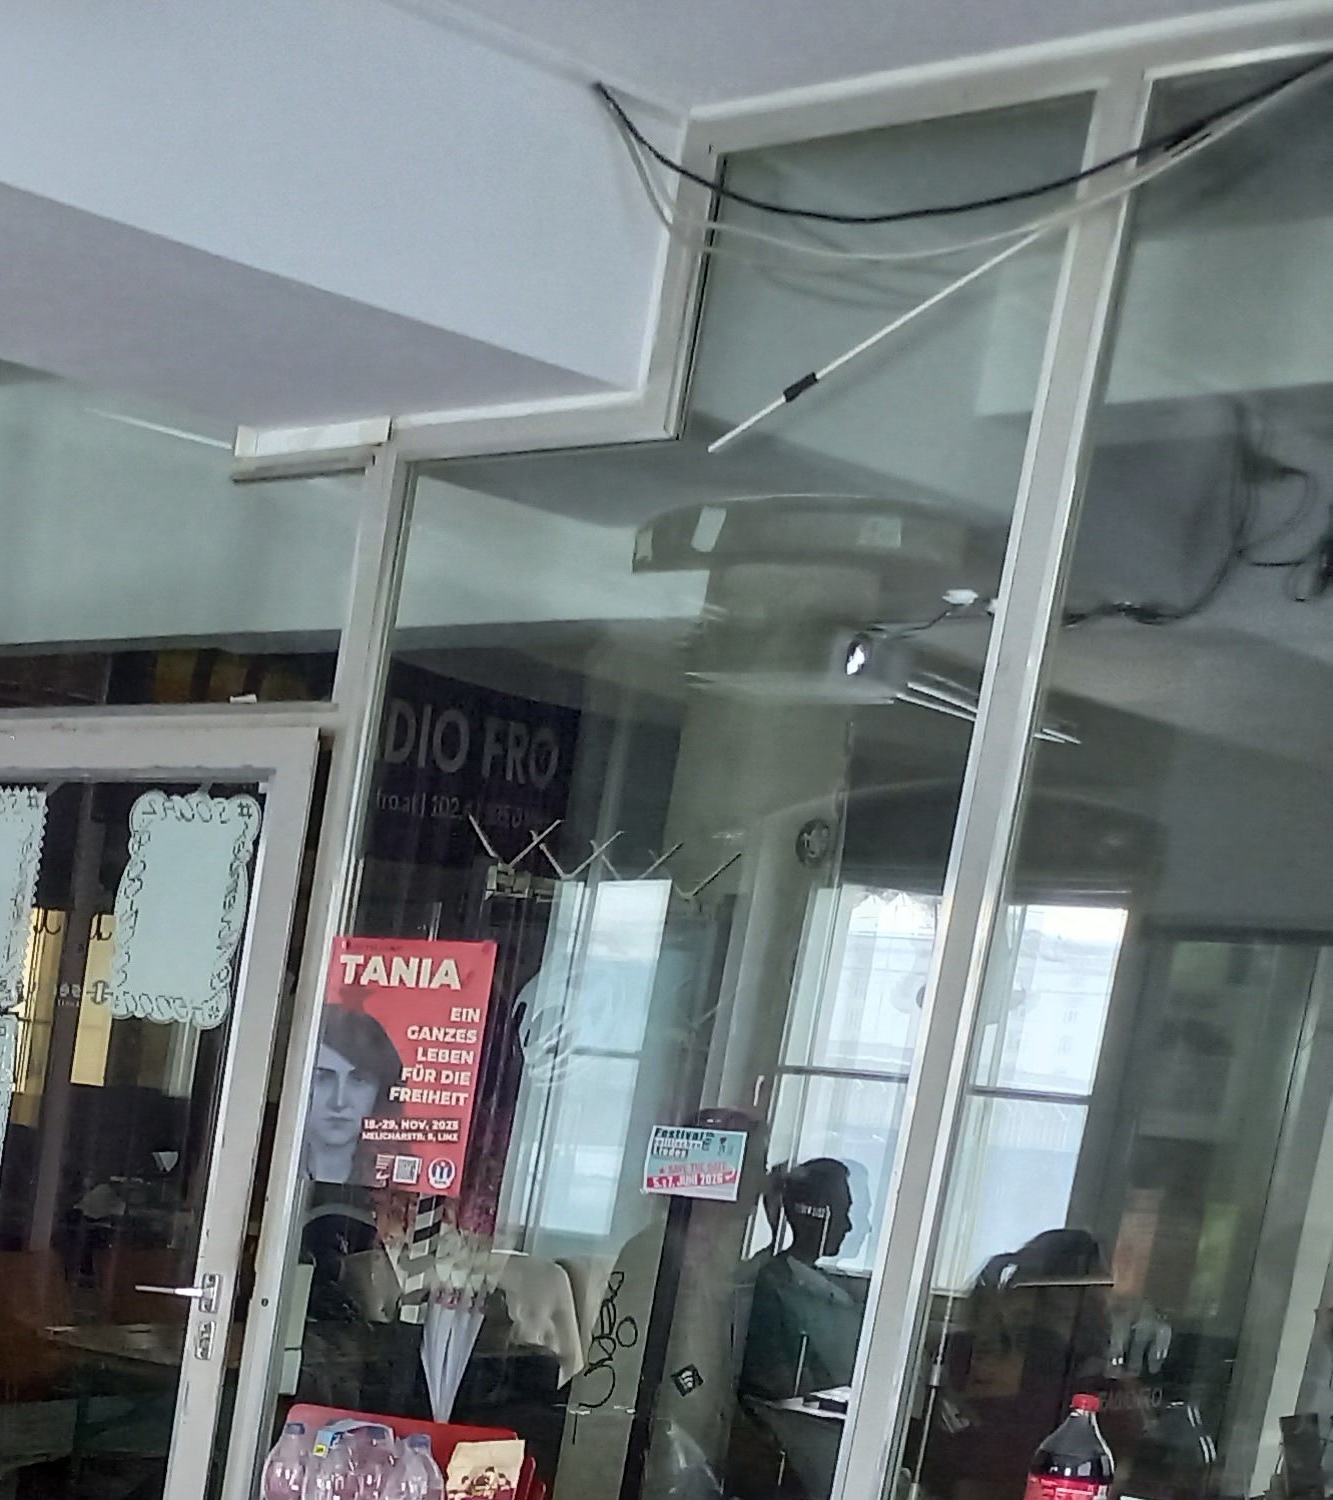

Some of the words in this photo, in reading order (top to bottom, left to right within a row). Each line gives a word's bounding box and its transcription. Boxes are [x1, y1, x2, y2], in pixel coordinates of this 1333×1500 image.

[340, 954, 462, 991] TANIA
[450, 1007, 481, 1023] EIN
[407, 1025, 478, 1044] GANZES
[416, 1047, 474, 1065] LEBEN
[401, 1064, 437, 1083] FÜR
[440, 1070, 472, 1086] DIE
[389, 1086, 469, 1106] FREIHEIT
